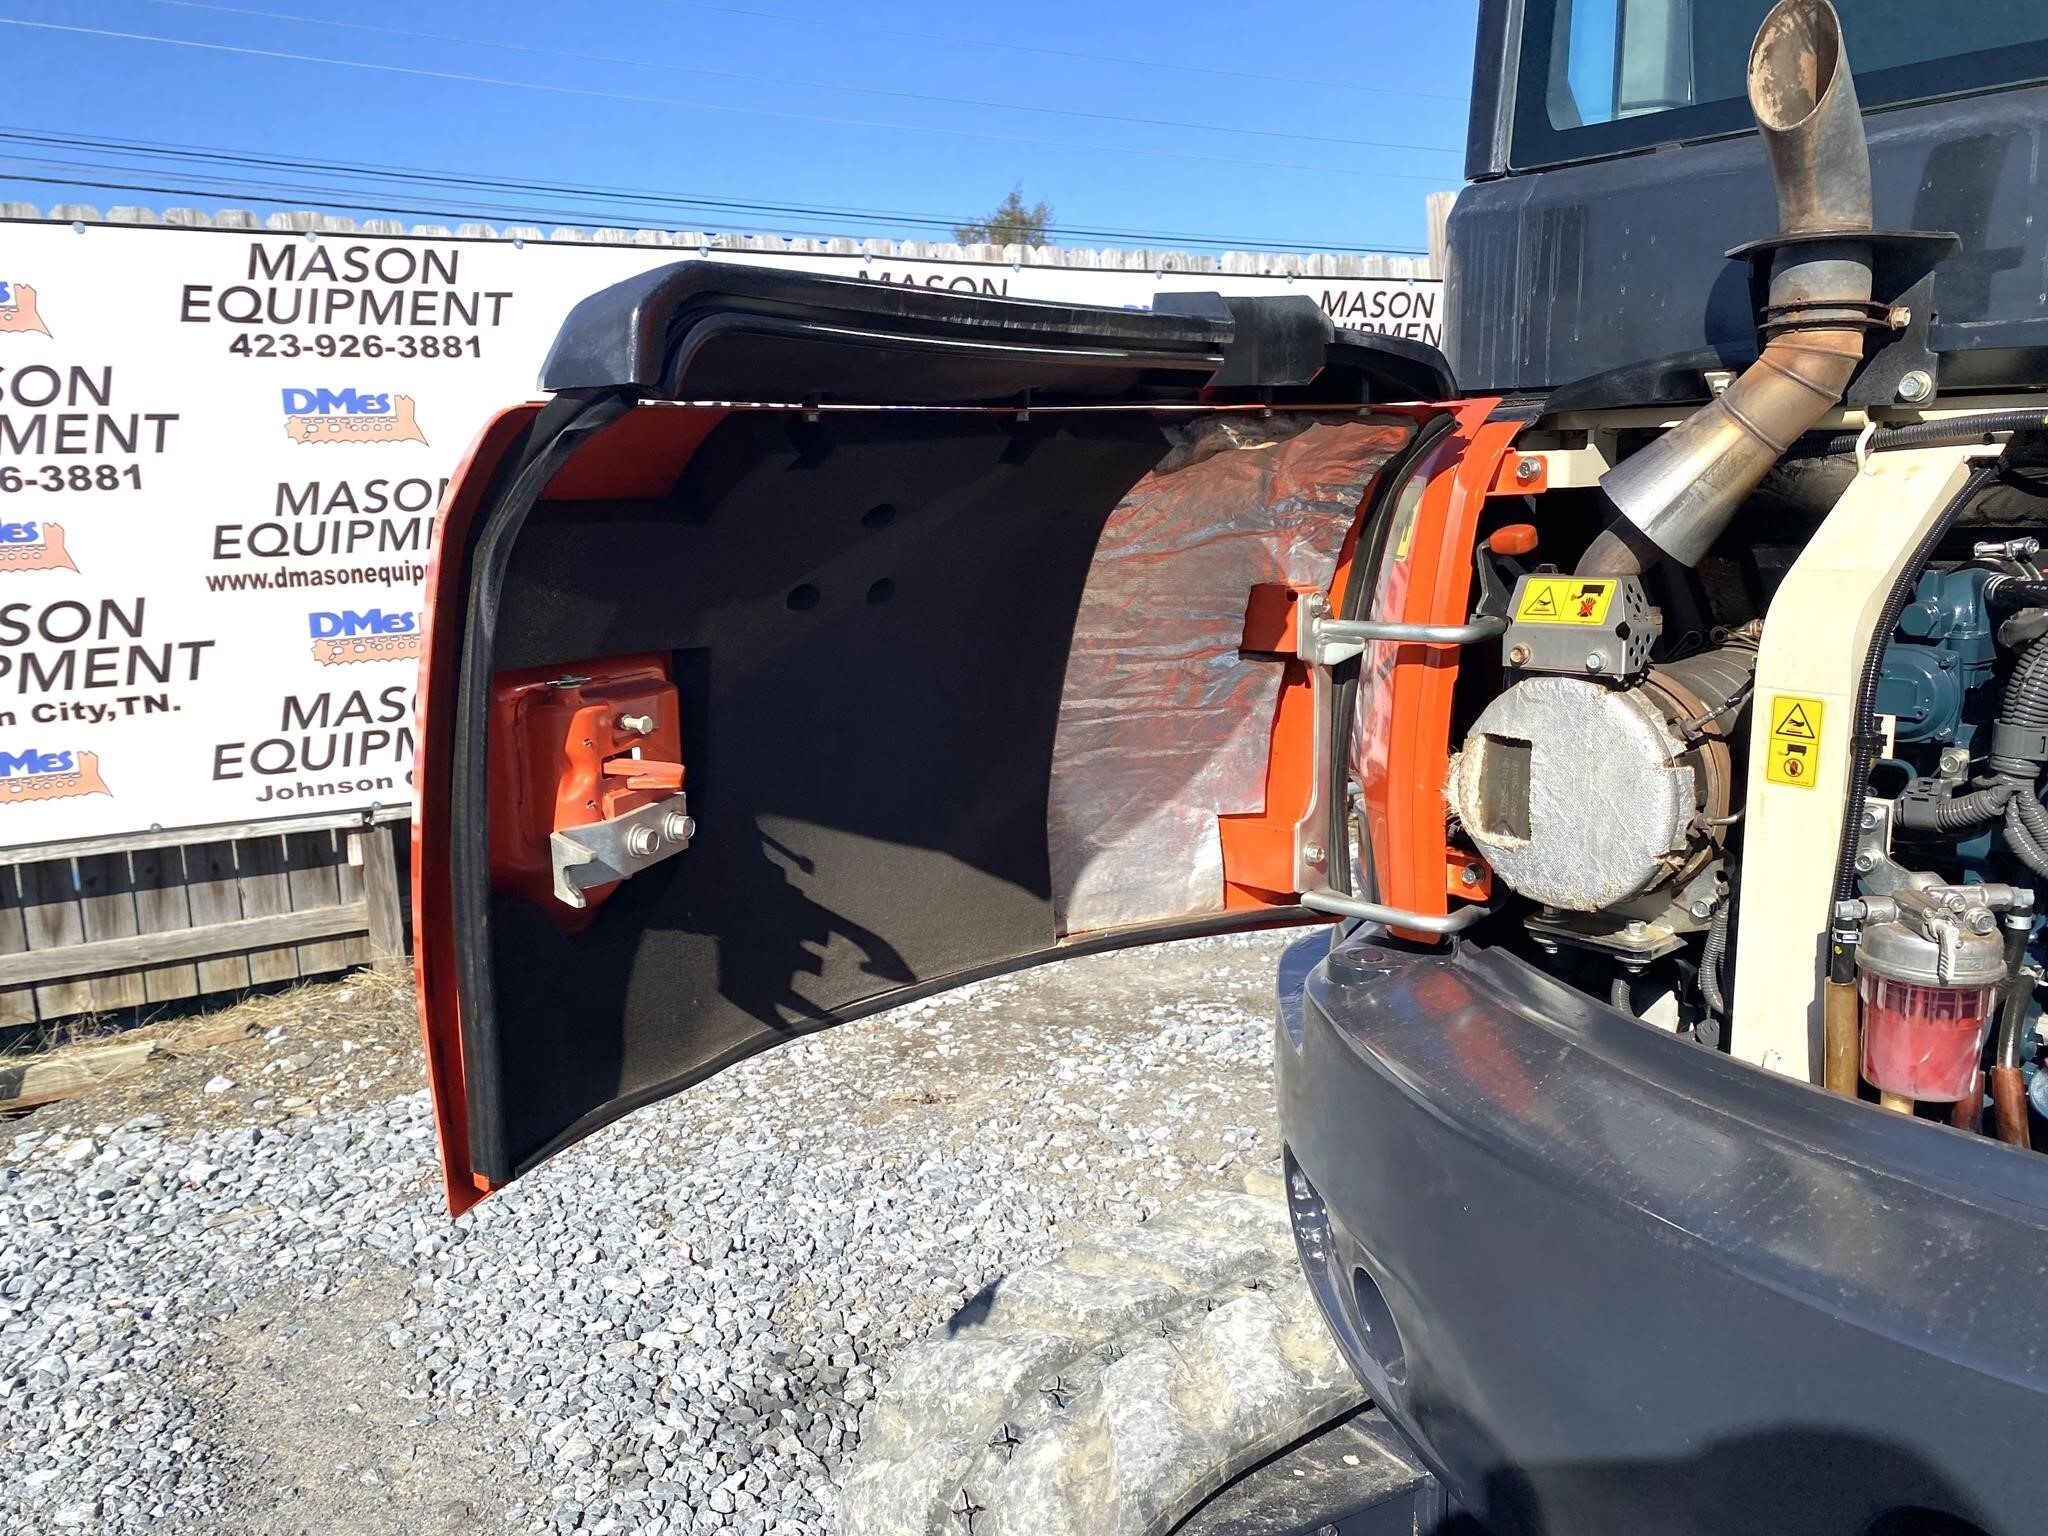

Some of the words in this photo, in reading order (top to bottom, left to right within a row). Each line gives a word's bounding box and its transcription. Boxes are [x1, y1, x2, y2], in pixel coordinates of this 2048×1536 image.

[247, 242, 459, 285] MASON
[180, 284, 514, 327] EQUIPMENT
[1320, 290, 1435, 319] MASON
[228, 333, 482, 359] 423-926-3881
[0, 364, 113, 407] ON
[0, 463, 142, 493] 6-3881
[212, 517, 435, 560] EQUIPM
[205, 560, 428, 592] www.dmasonequip
[281, 685, 417, 732] MAS
[255, 776, 393, 802] Johnson
